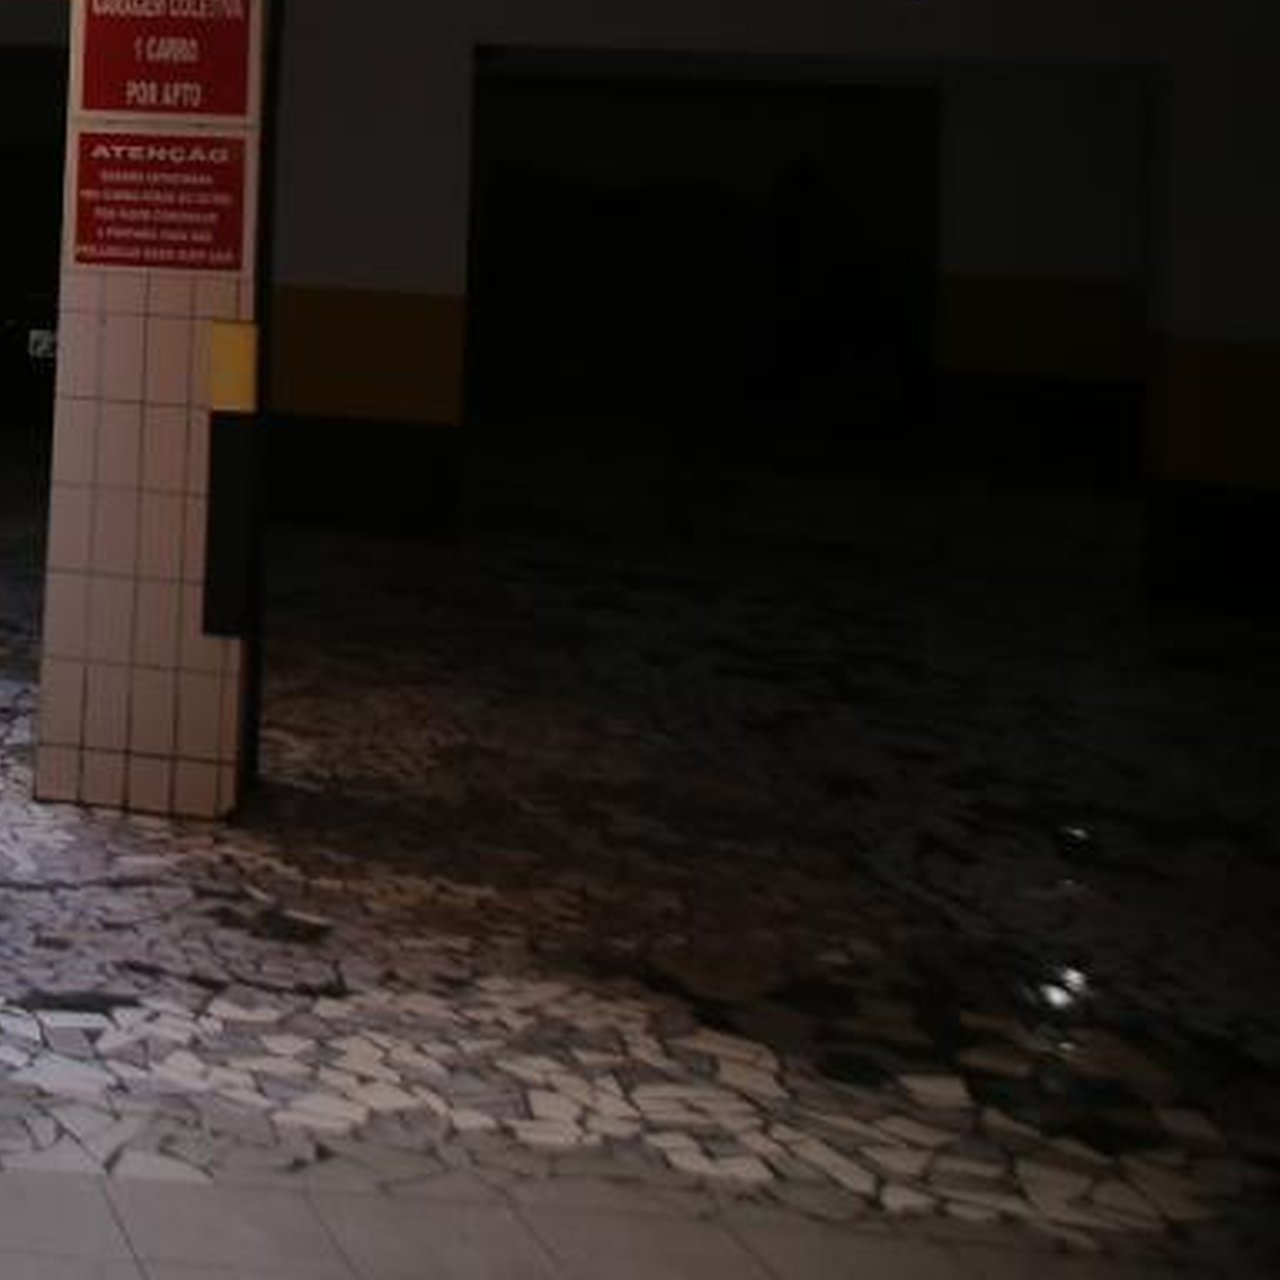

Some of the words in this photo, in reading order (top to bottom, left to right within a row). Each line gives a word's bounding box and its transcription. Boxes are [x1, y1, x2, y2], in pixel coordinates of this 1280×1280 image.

[135, 37, 143, 62] 1
[146, 36, 199, 62] CARRO
[126, 81, 157, 105] POR
[162, 82, 201, 107] APTO
